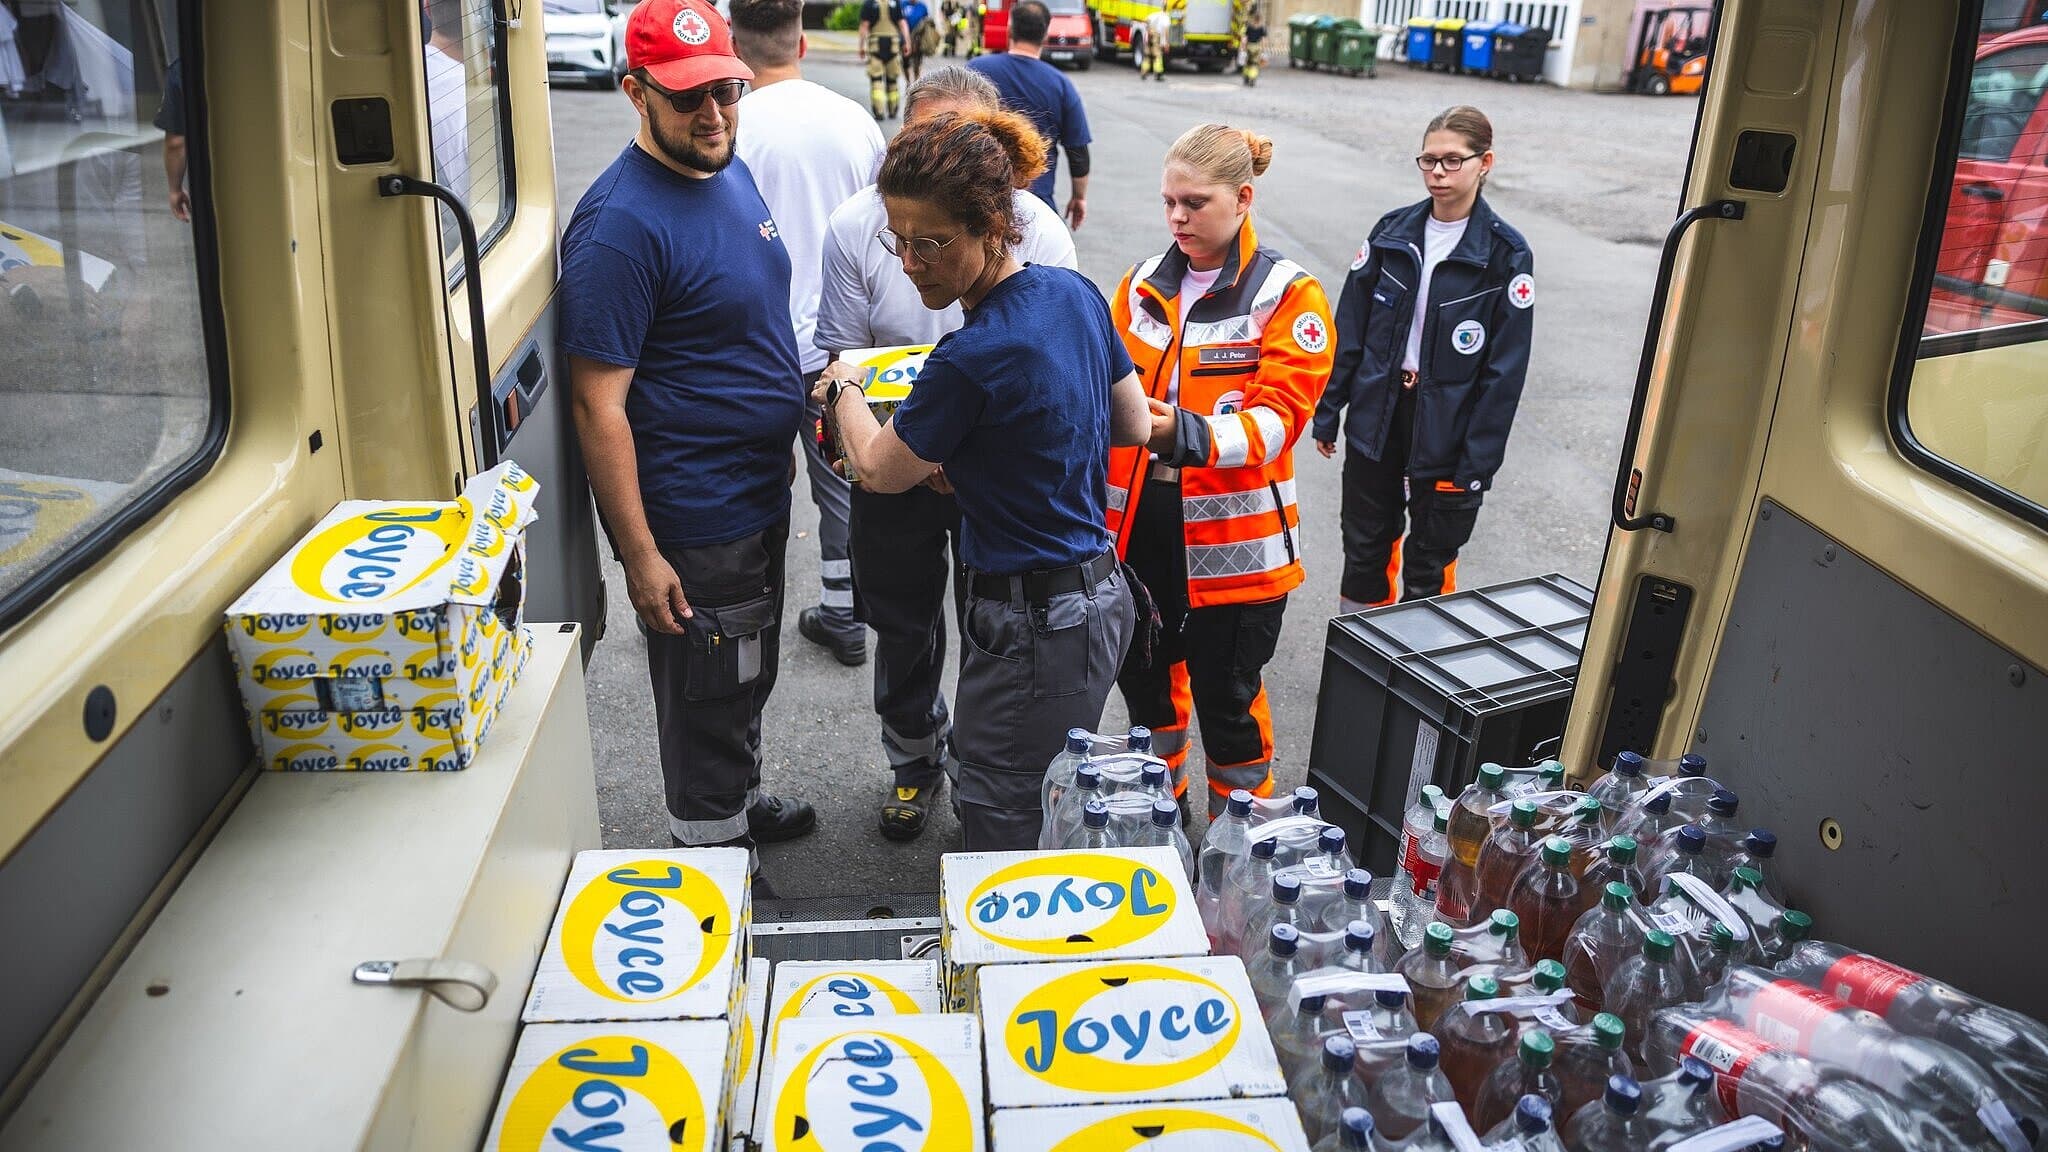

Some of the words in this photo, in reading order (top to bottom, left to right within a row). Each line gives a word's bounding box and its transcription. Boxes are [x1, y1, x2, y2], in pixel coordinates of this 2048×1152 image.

[1229, 351, 1247, 359] Peter
[484, 489, 506, 529] Joyce
[339, 509, 443, 598] Joyce
[468, 524, 492, 558] Joyce
[450, 557, 475, 596] Joyce
[241, 613, 308, 636] Joyce
[318, 613, 385, 636] Joyce
[253, 662, 317, 684] Joyce
[266, 709, 329, 732] Joyce
[338, 705, 402, 732] Joyce
[274, 758, 337, 771] Joyce
[347, 756, 411, 771] Joyce
[975, 868, 1168, 924] Joyce
[604, 866, 683, 996] Joyce
[1016, 998, 1231, 1073] Joyce
